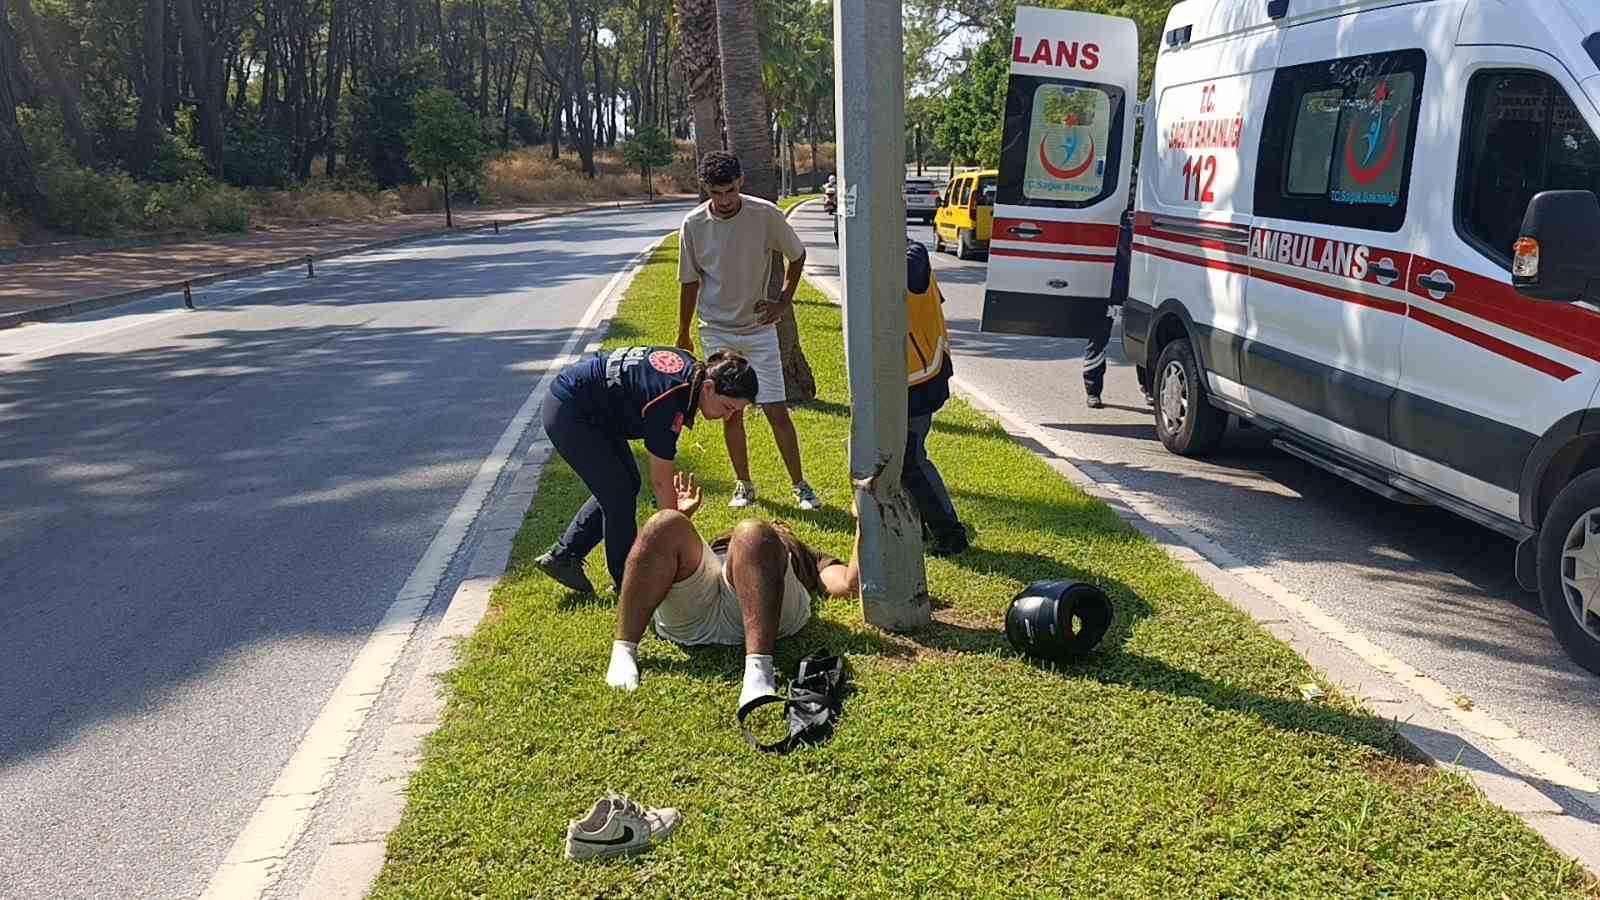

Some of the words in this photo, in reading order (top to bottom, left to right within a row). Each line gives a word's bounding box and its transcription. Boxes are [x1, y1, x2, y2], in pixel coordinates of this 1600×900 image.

[1013, 36, 1100, 71] LANS
[1183, 155, 1216, 202] 112
[1249, 229, 1370, 280] AMBULANS
